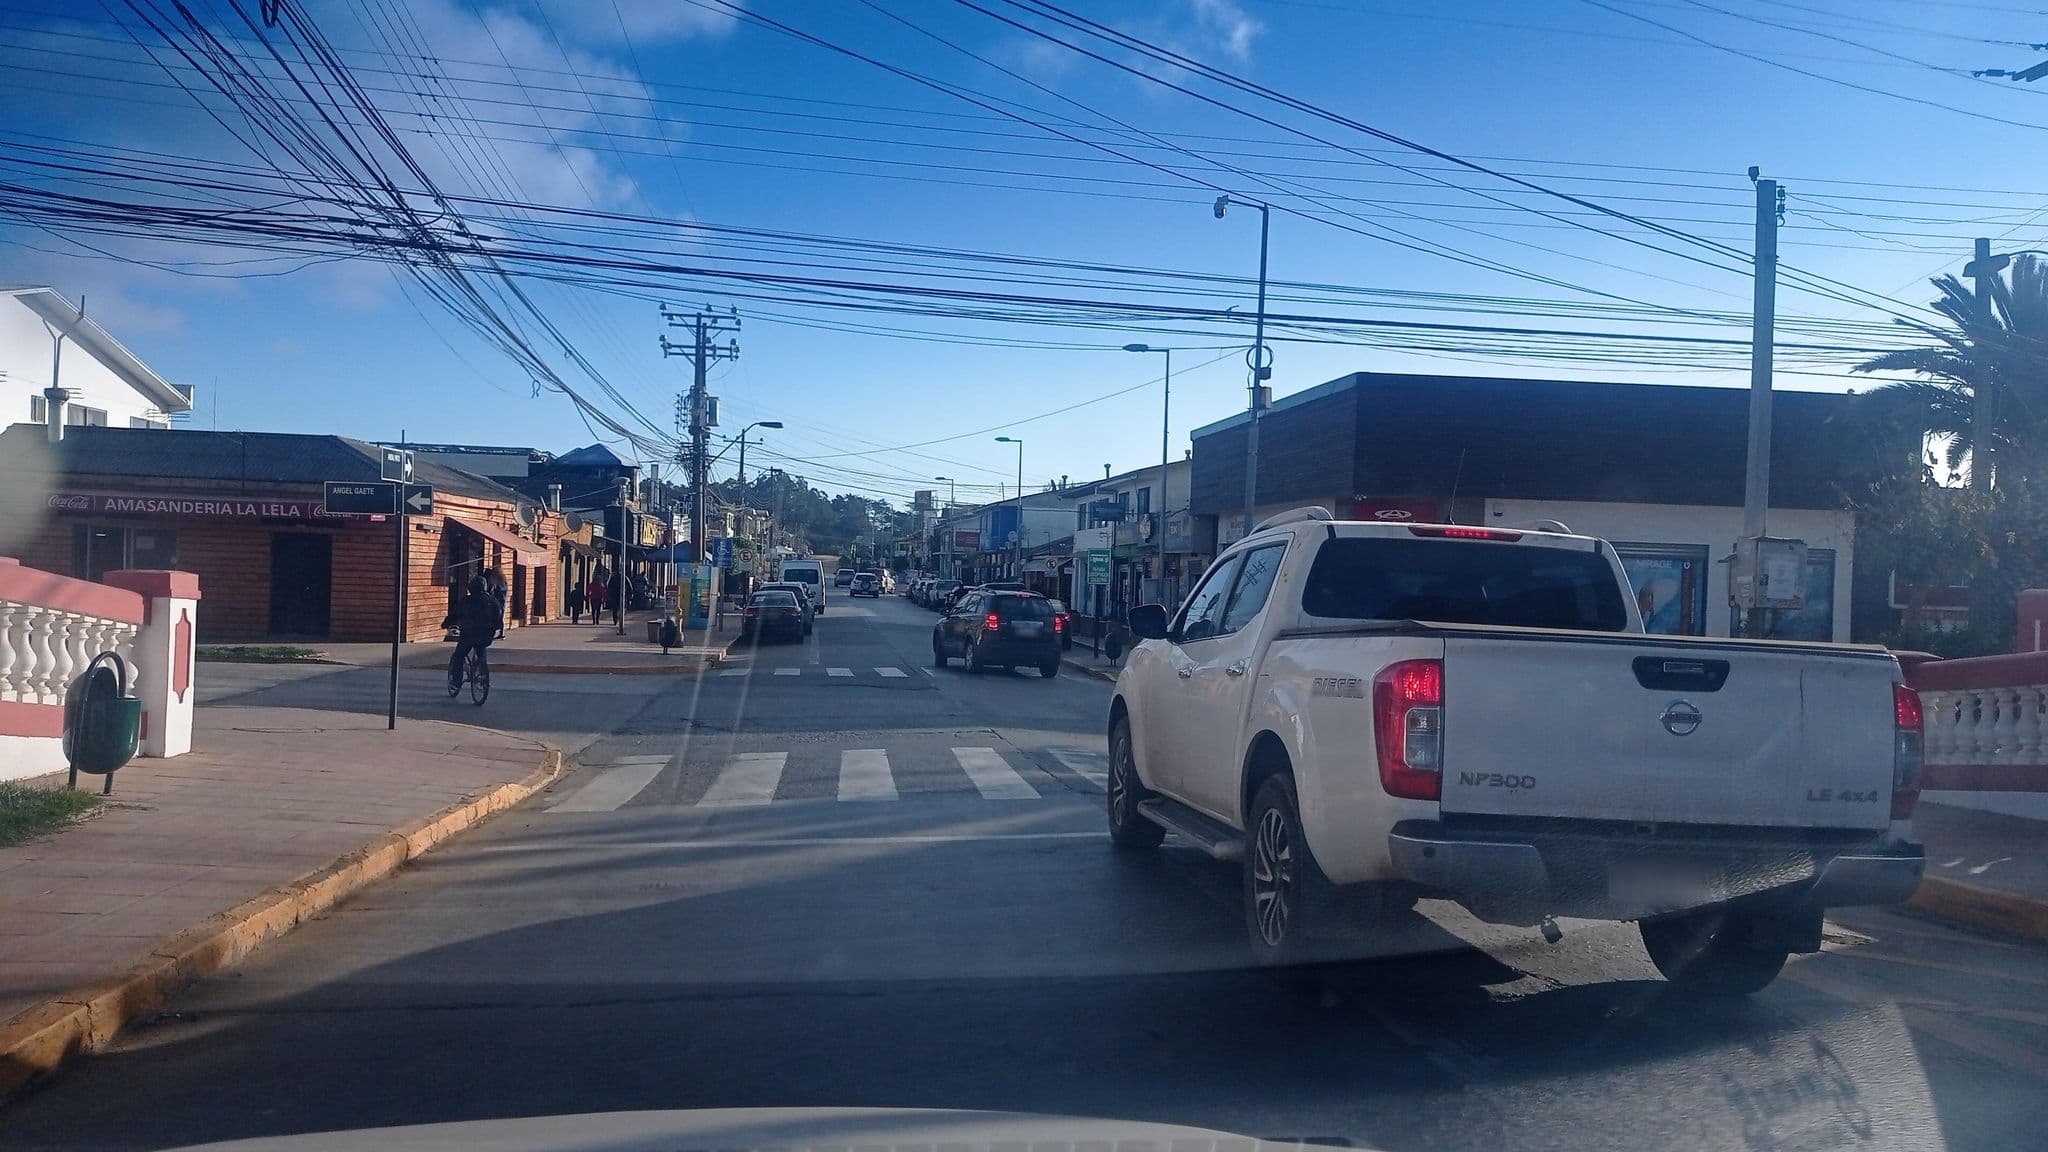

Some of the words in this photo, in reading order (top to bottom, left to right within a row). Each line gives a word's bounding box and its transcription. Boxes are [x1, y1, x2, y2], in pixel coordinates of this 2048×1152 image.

[332, 487, 353, 495] ANGEL
[354, 487, 375, 496] GAETE
[105, 498, 233, 516] AMASANDERIA
[236, 503, 257, 516] LA
[262, 504, 301, 518] LELA
[1459, 772, 1536, 789] NP300
[1807, 789, 1833, 802] LE
